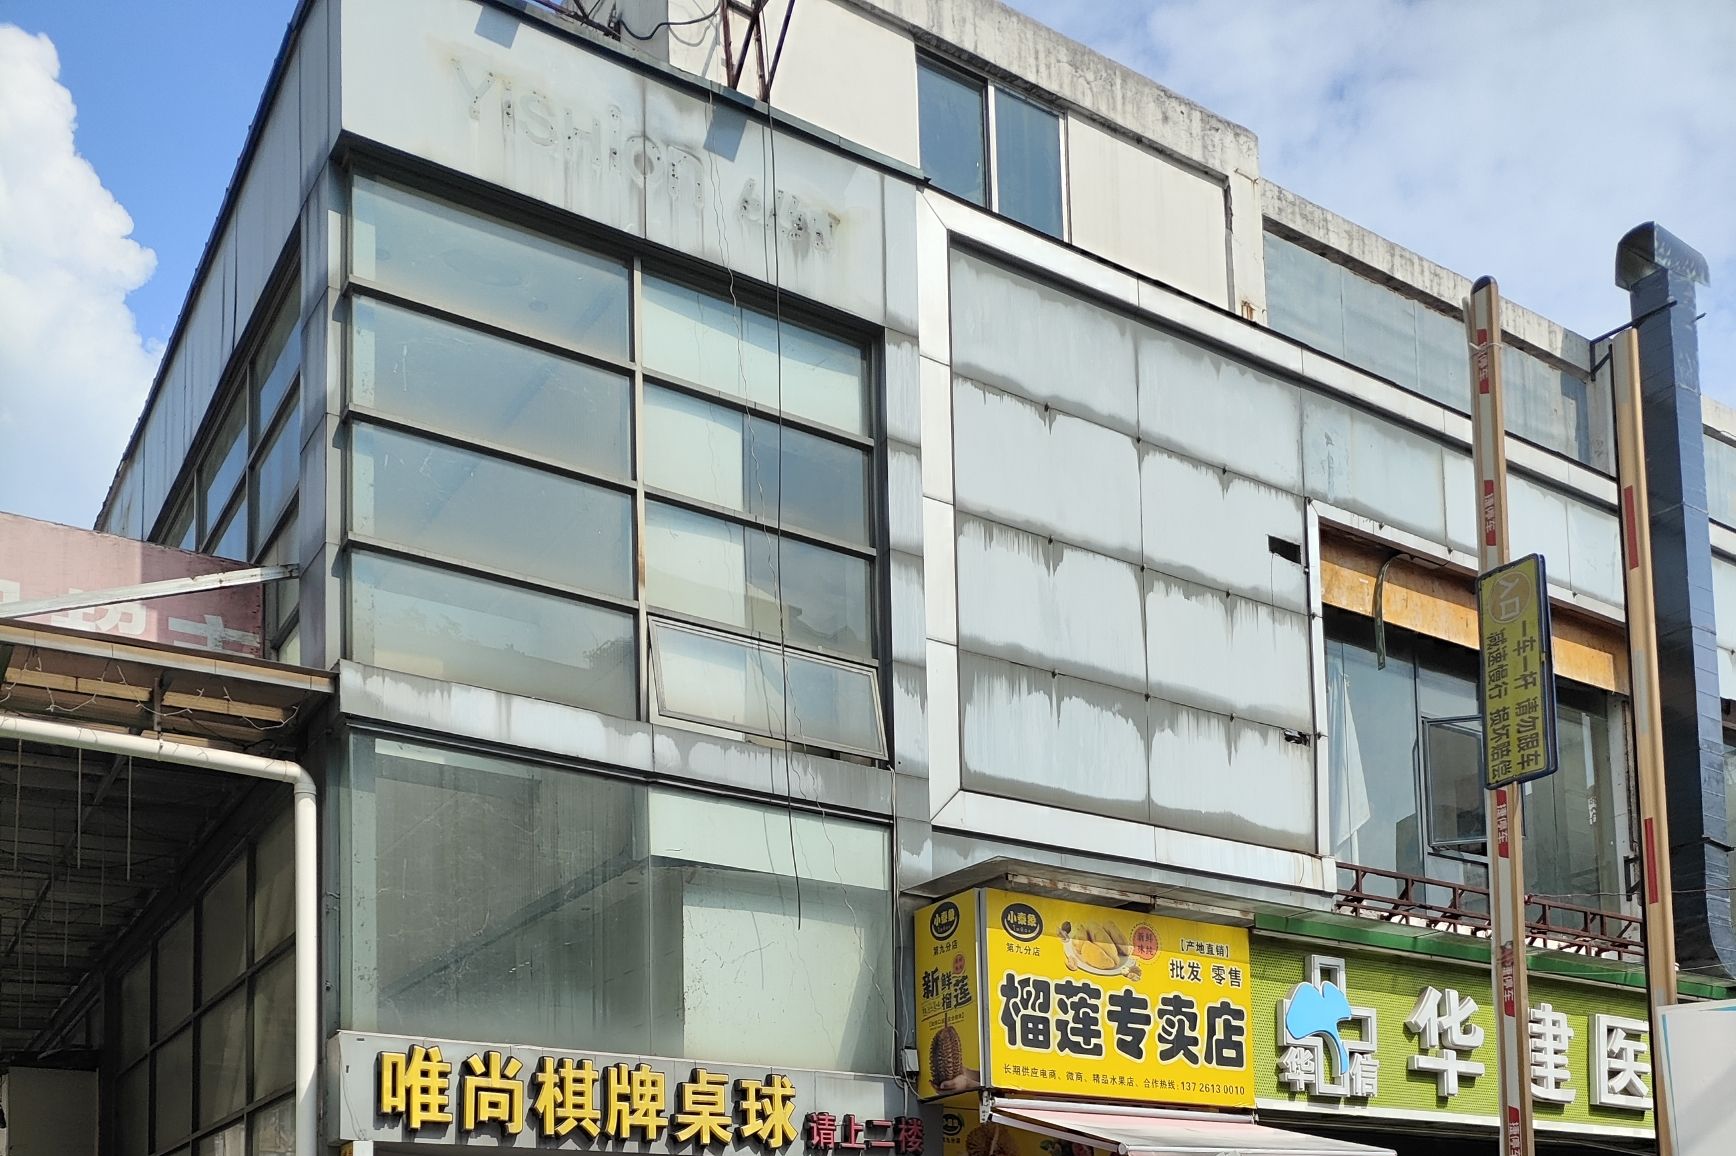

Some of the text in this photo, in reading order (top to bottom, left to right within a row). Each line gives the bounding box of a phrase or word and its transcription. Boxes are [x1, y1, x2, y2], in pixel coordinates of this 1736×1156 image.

[1498, 577, 1521, 621] 入口
[1486, 628, 1511, 780] 减速慢行 损坏赔偿
[1515, 697, 1541, 771] 请勿跟车
[933, 940, 958, 956] 第九分店
[1006, 943, 1040, 957] 第九分店
[1170, 959, 1242, 987] 批发 零售
[1001, 973, 1245, 1069] 榴莲专卖店
[377, 1044, 799, 1149] 唯尚棋牌桌球
[805, 1111, 925, 1155] 请上二楼
